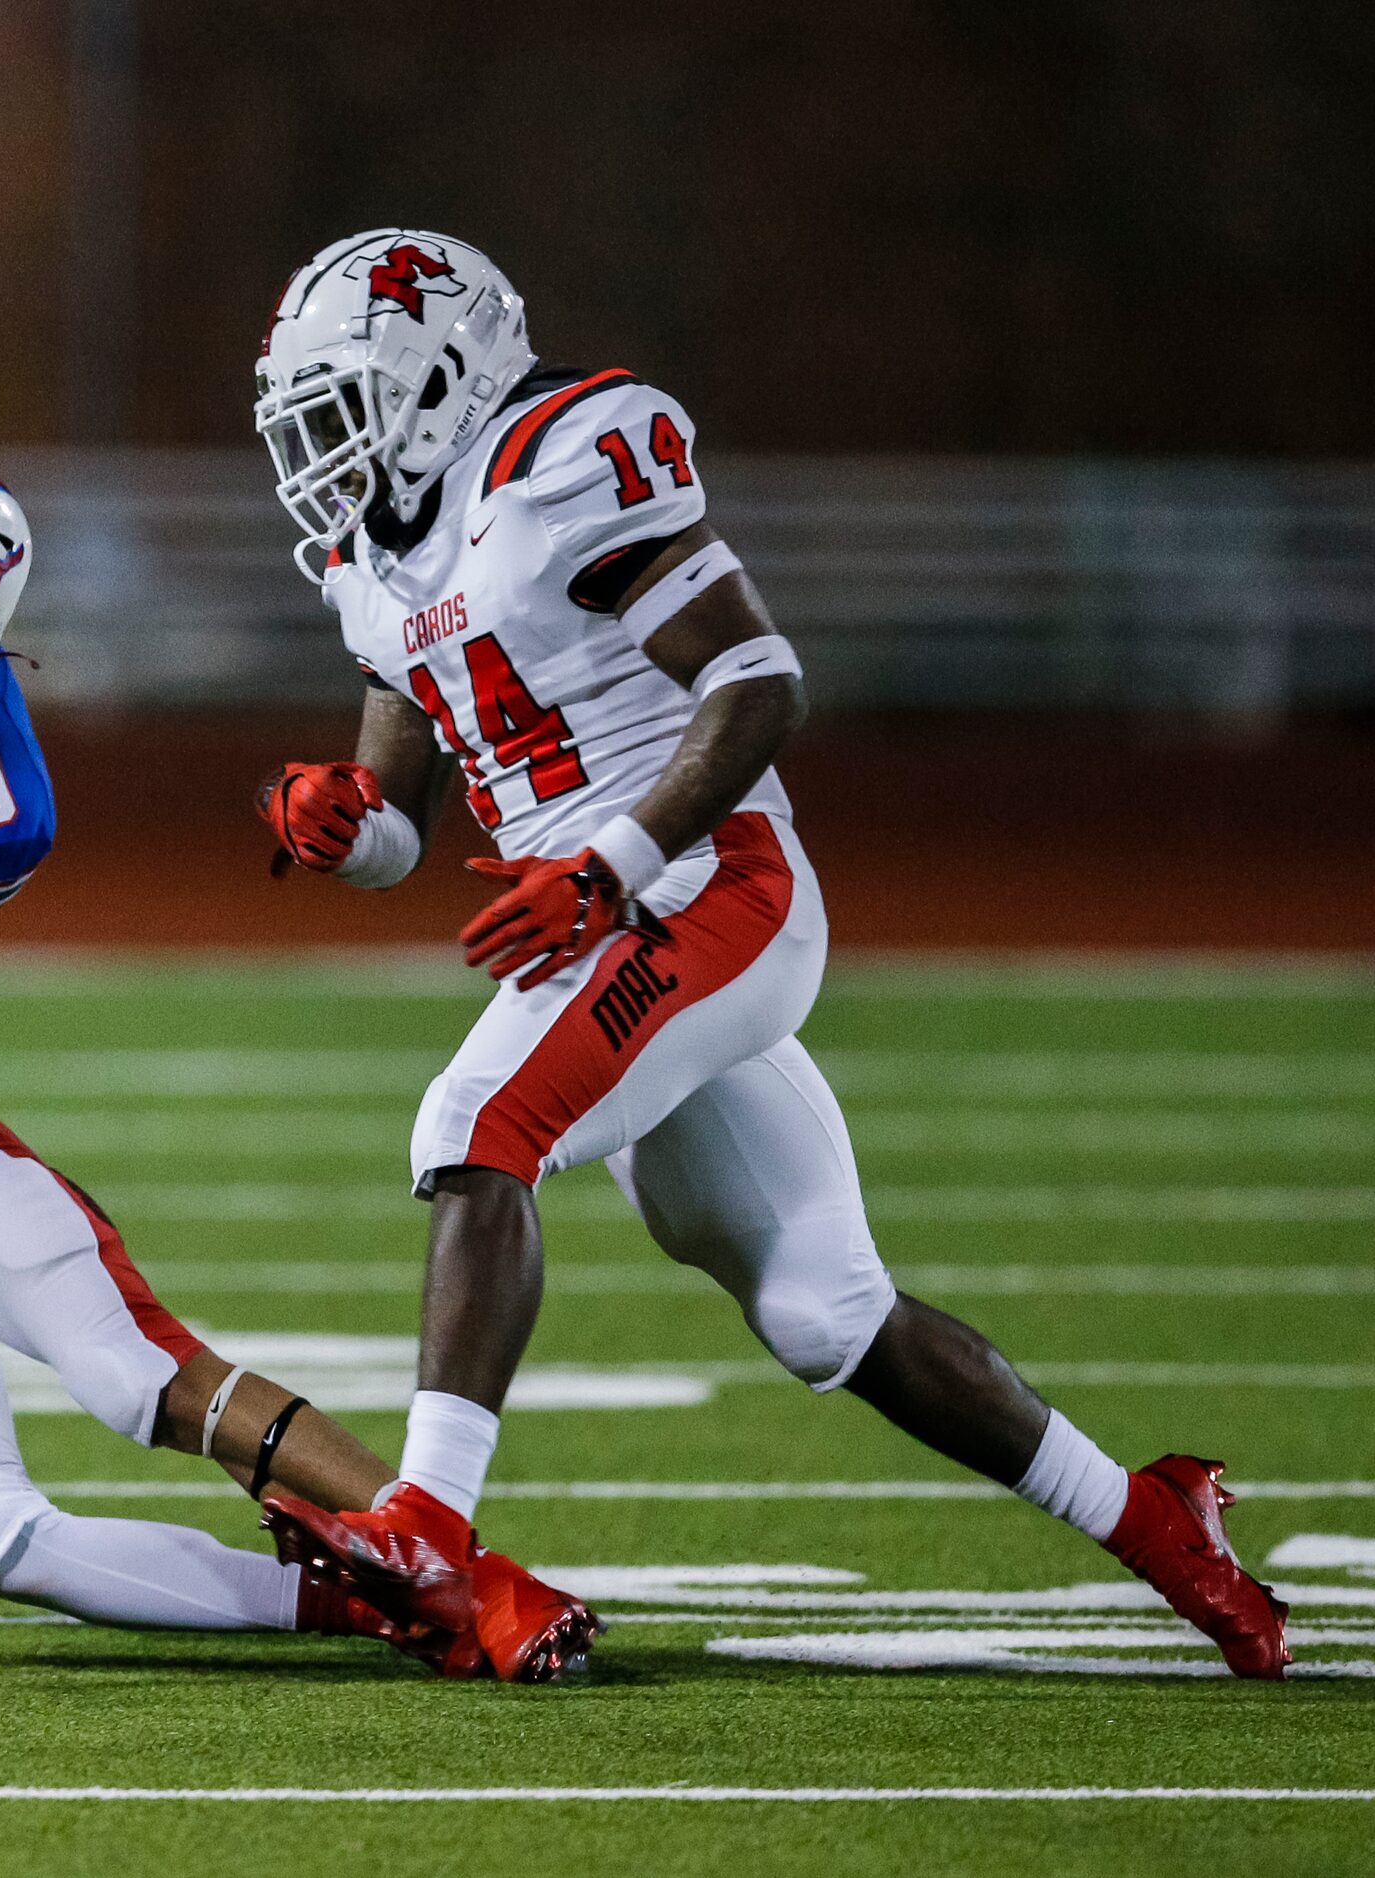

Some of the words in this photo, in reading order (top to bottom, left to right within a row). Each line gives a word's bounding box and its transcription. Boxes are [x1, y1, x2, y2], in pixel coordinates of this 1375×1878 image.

[595, 412, 694, 511] 14
[403, 592, 469, 654] CARDS
[408, 631, 592, 830] 14
[590, 942, 679, 1054] MAC
